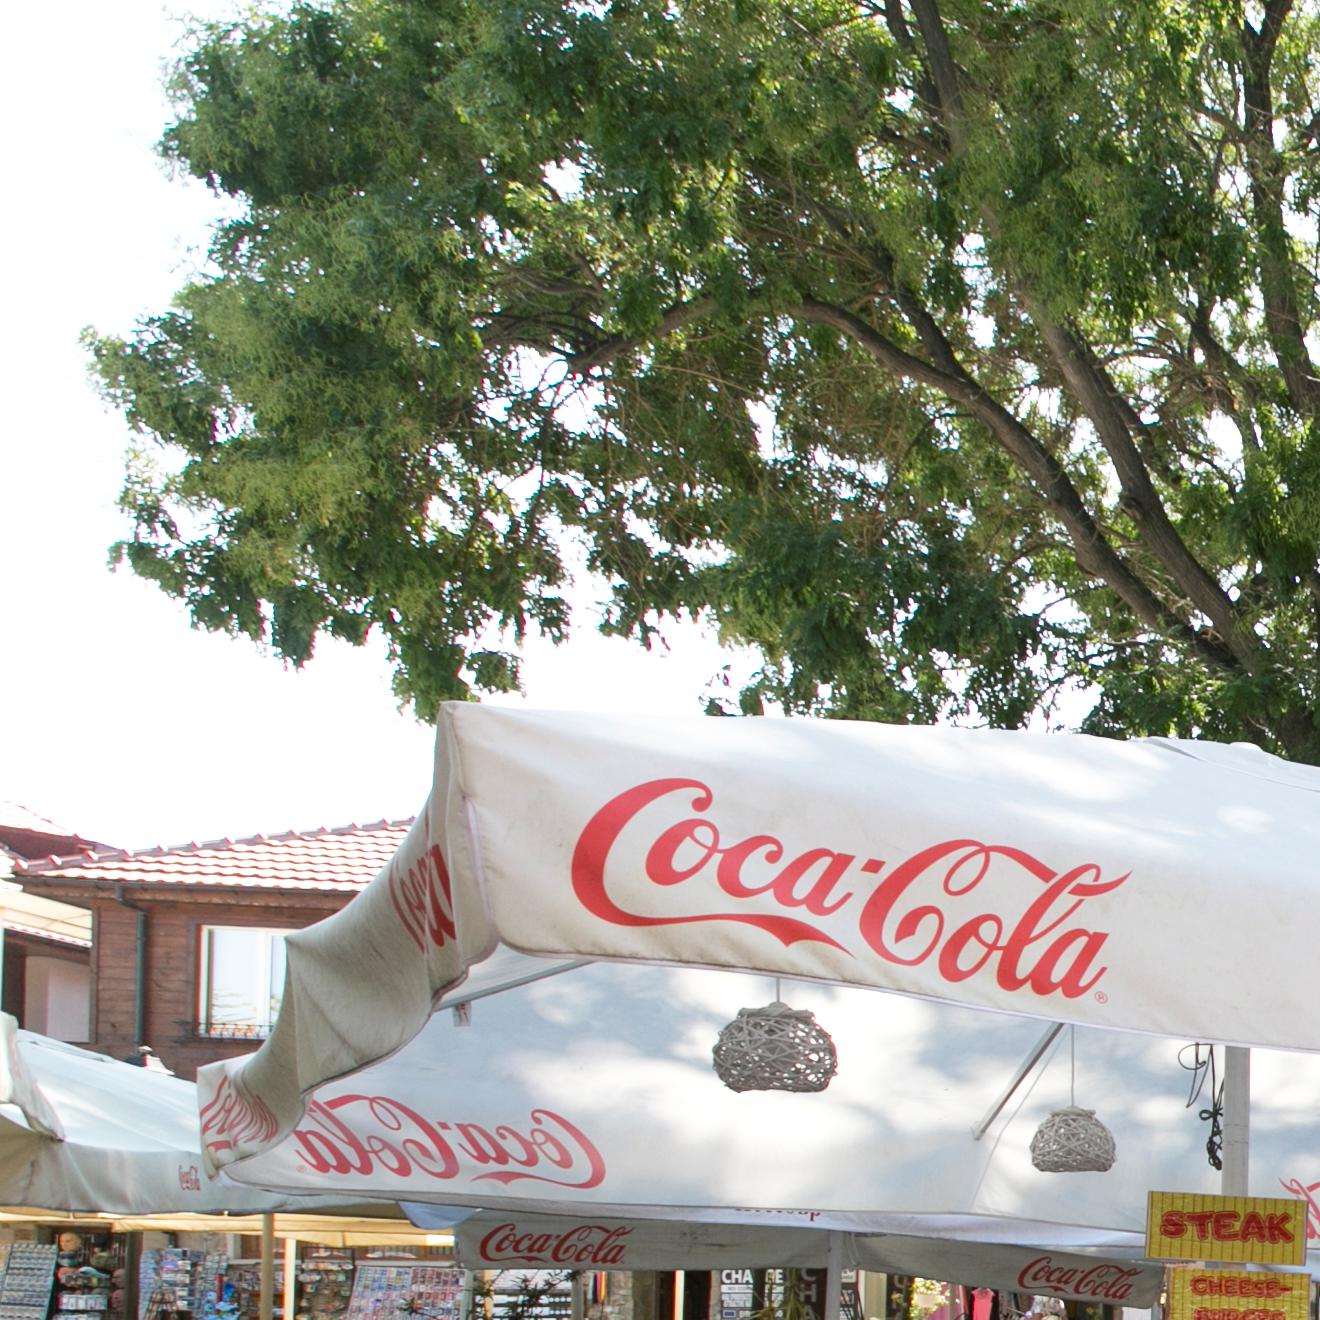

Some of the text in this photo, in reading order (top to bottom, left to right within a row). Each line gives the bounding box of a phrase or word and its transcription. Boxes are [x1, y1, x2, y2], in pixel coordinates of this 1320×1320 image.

[571, 777, 1132, 999] Coca-Cola
[480, 1222, 635, 1264] Coca-Cola
[1160, 1211, 1295, 1244] STEAK
[1018, 1256, 1144, 1299] Coca-Cola
